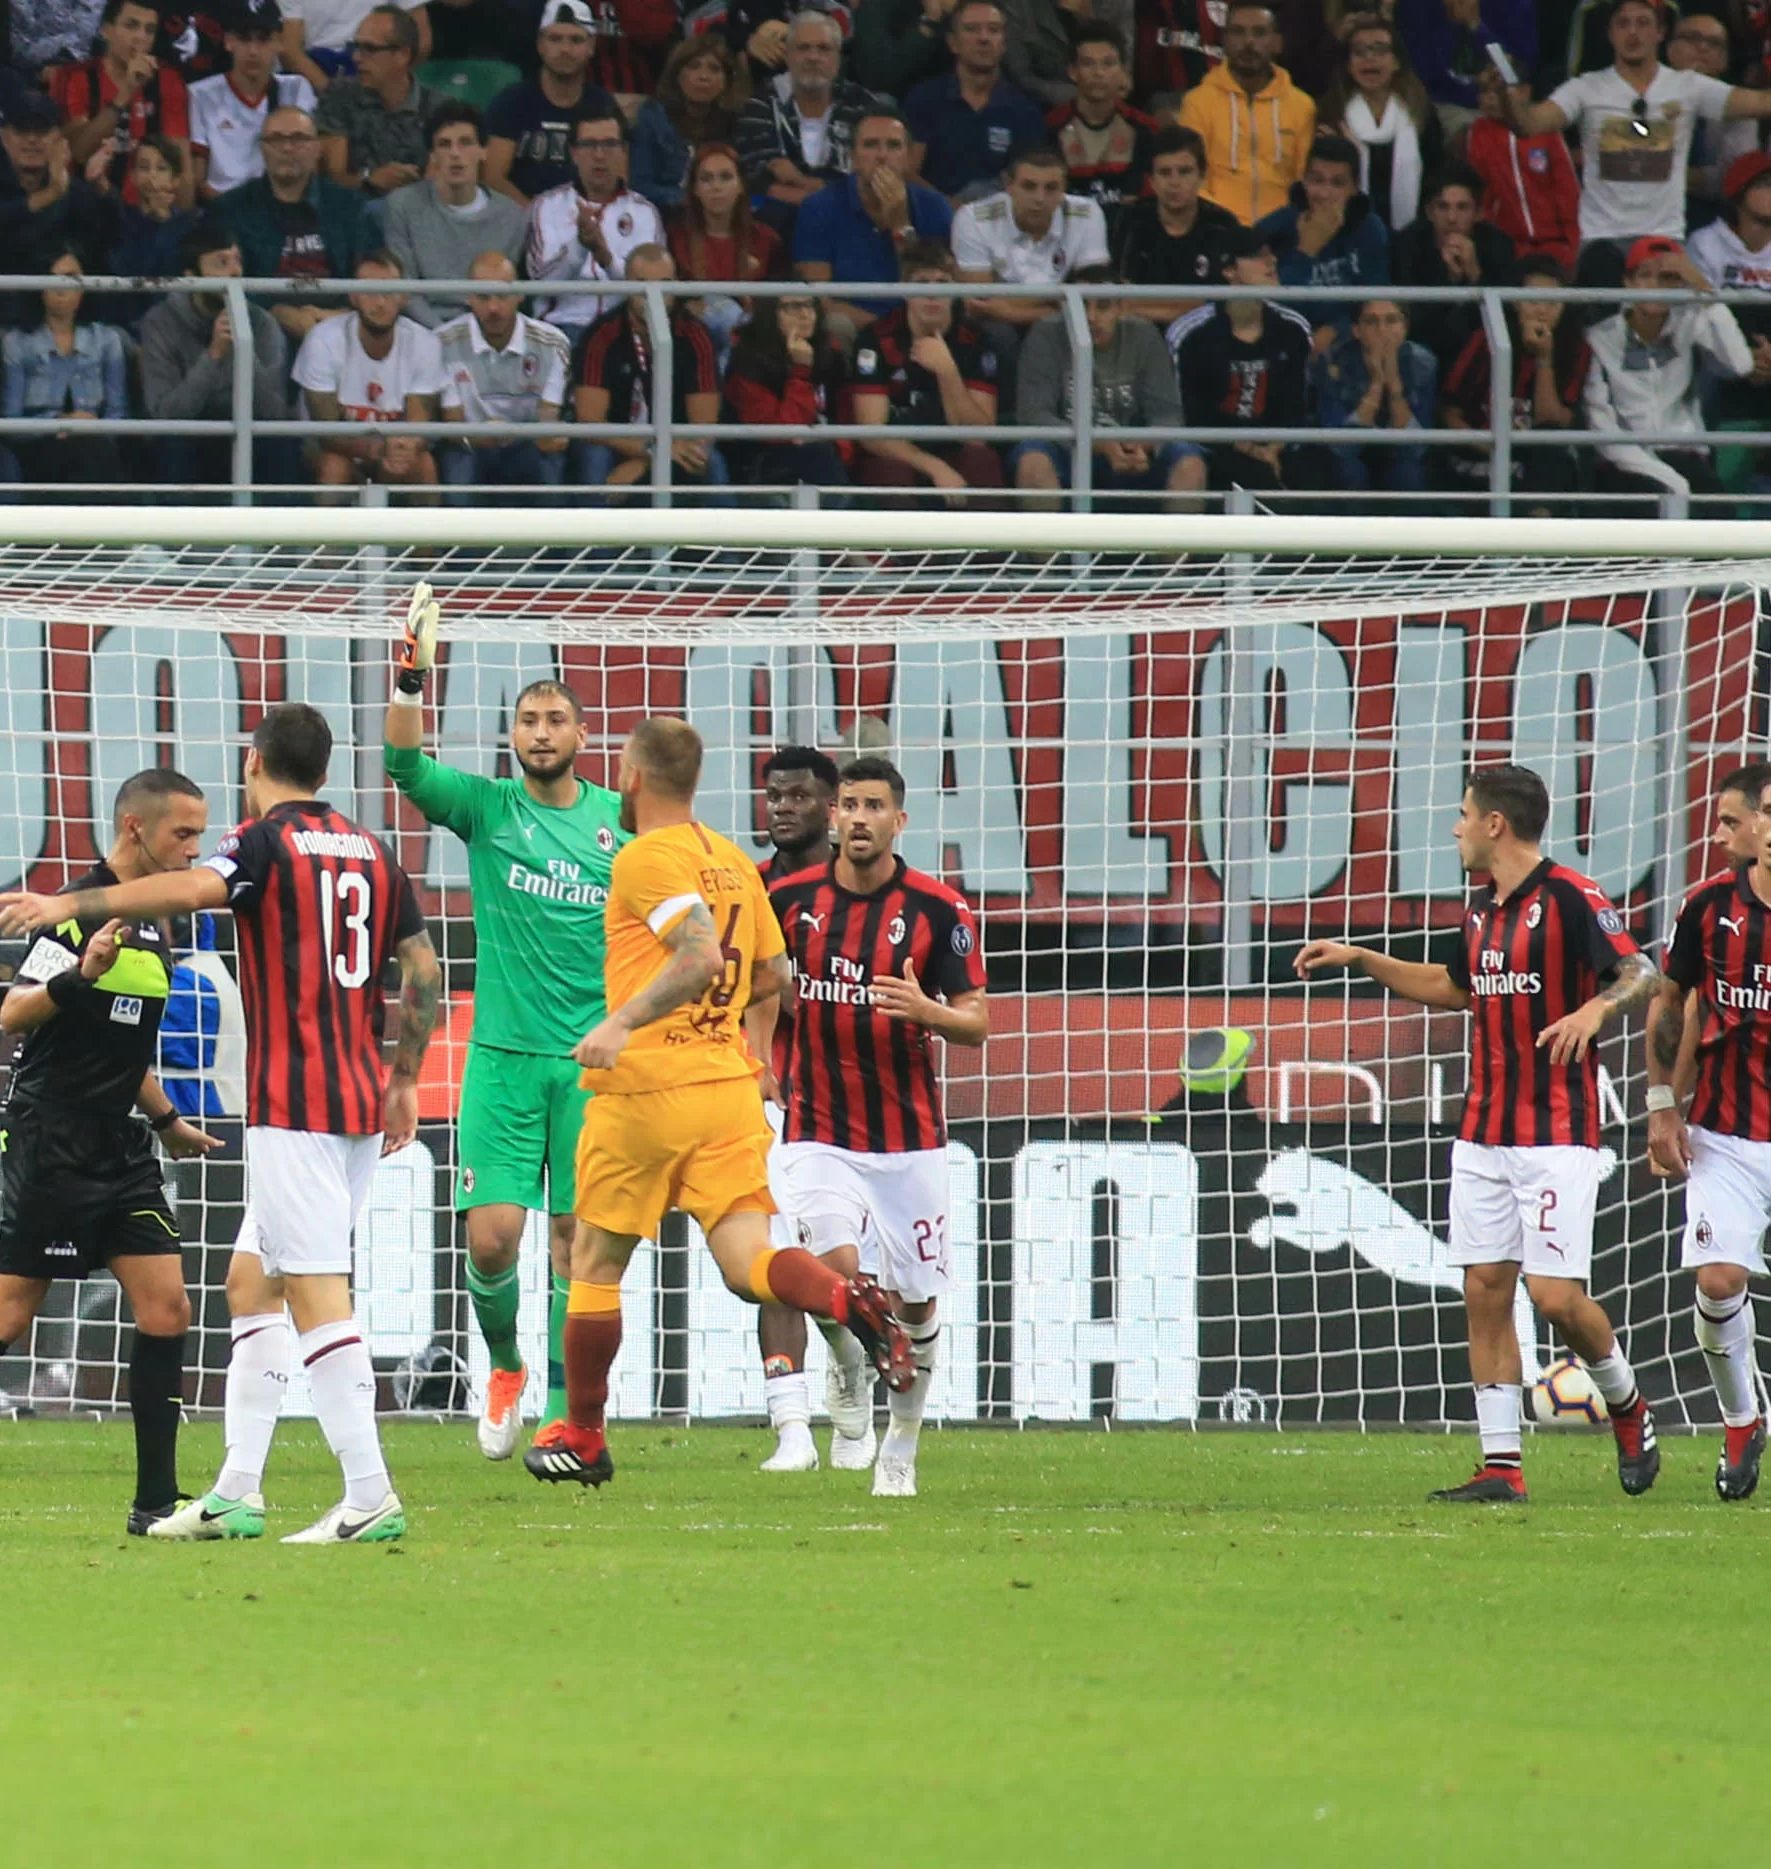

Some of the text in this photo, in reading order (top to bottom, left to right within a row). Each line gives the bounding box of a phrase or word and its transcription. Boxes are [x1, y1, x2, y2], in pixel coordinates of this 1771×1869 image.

[684, 618, 1662, 901] CALCIO
[291, 830, 377, 861] ROMAGNOLI
[547, 859, 581, 881] Fly
[320, 869, 371, 989] 13
[28, 957, 56, 976] VIT
[34, 942, 74, 969] EURO
[830, 955, 865, 982] Fly
[1482, 949, 1504, 970] Fly
[1470, 968, 1542, 996] mirates
[1753, 963, 1771, 984] Fl
[798, 972, 887, 1005] Emira
[1715, 978, 1771, 1011] Emir
[1539, 1189, 1557, 1232] 2
